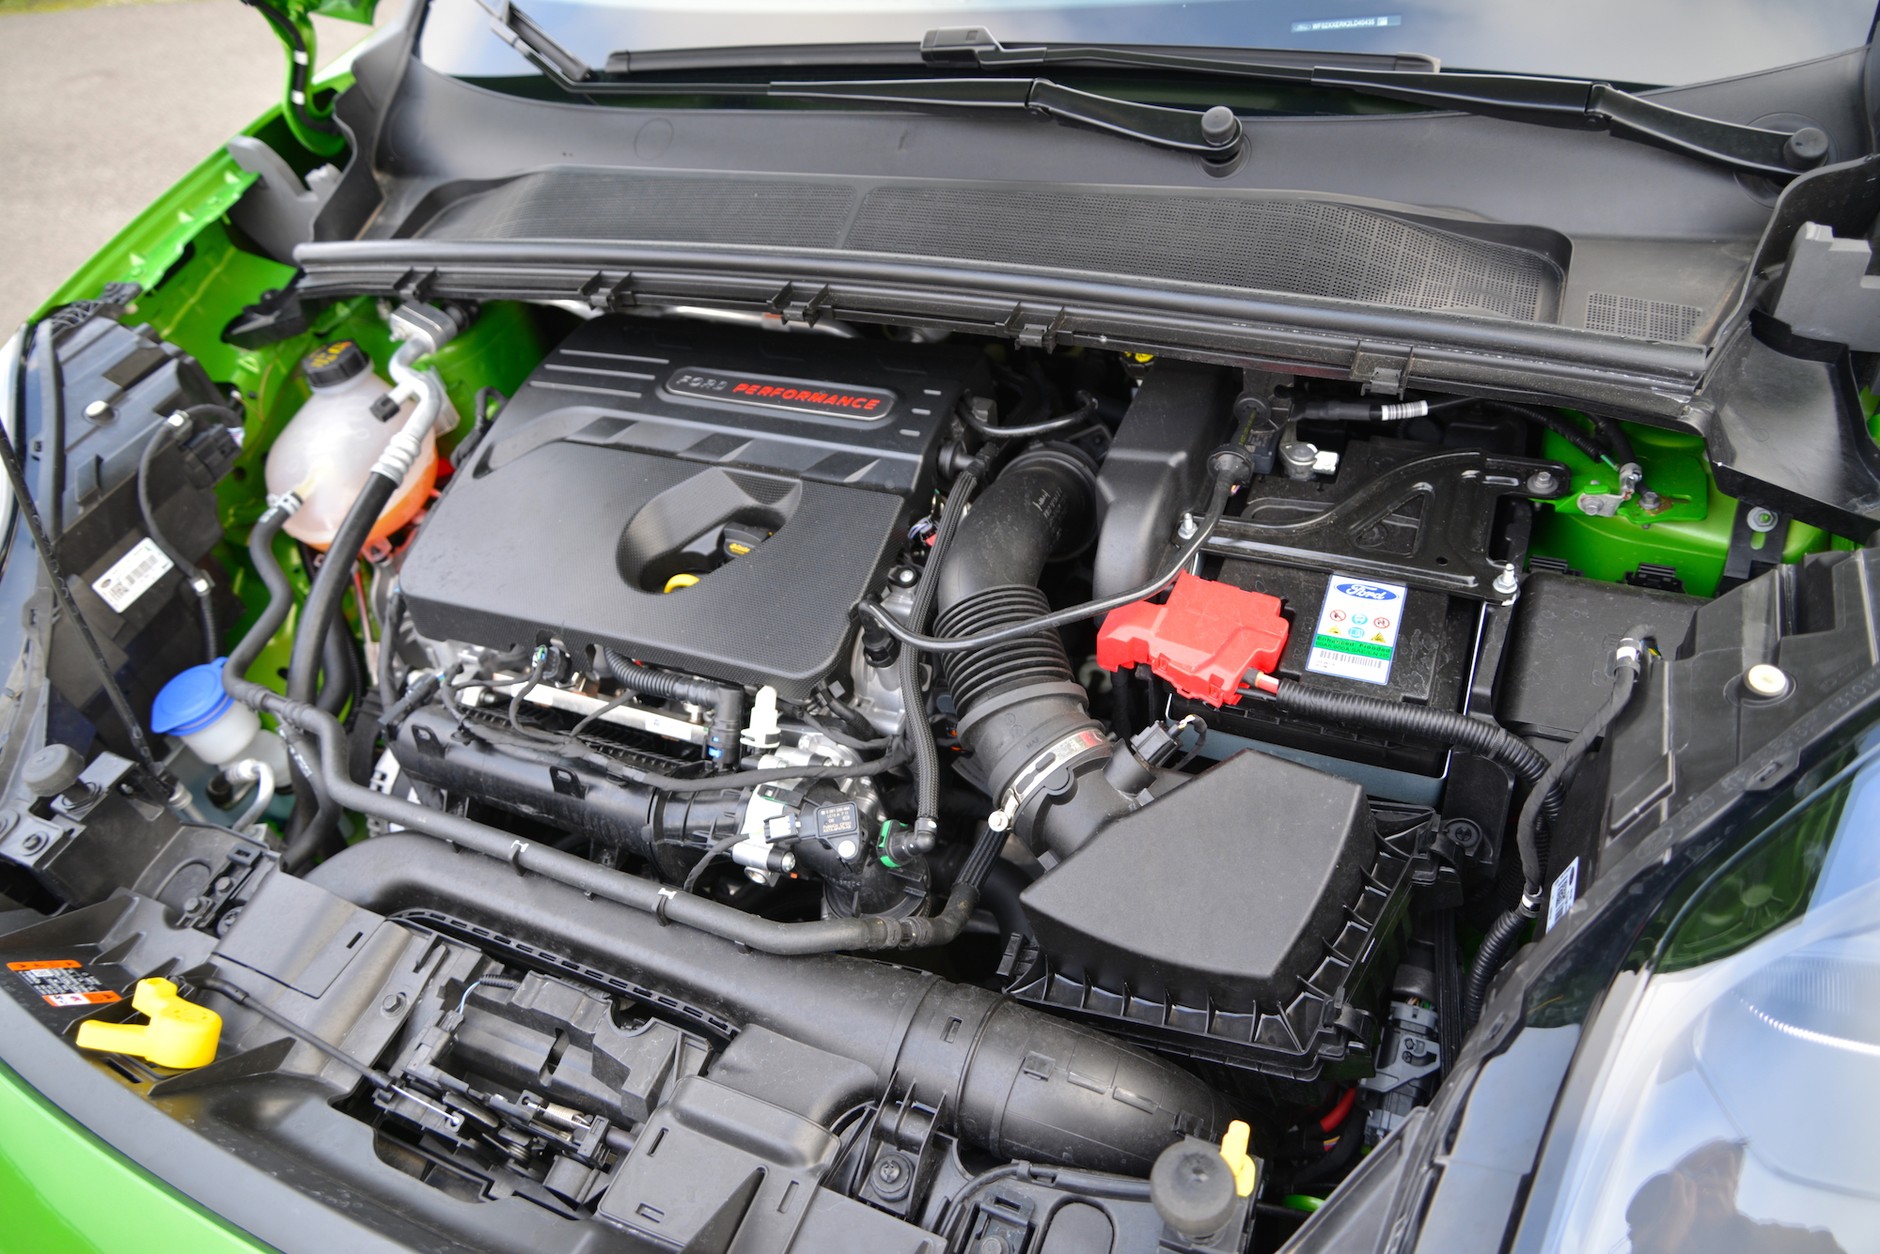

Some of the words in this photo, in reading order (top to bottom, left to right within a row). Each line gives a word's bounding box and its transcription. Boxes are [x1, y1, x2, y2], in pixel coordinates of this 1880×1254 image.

[676, 375, 728, 391] FORD
[732, 382, 880, 411] PERFORMANCE
[1346, 583, 1385, 600] Ford
[1316, 635, 1355, 648] Enhanced
[1358, 643, 1391, 654] Flooded
